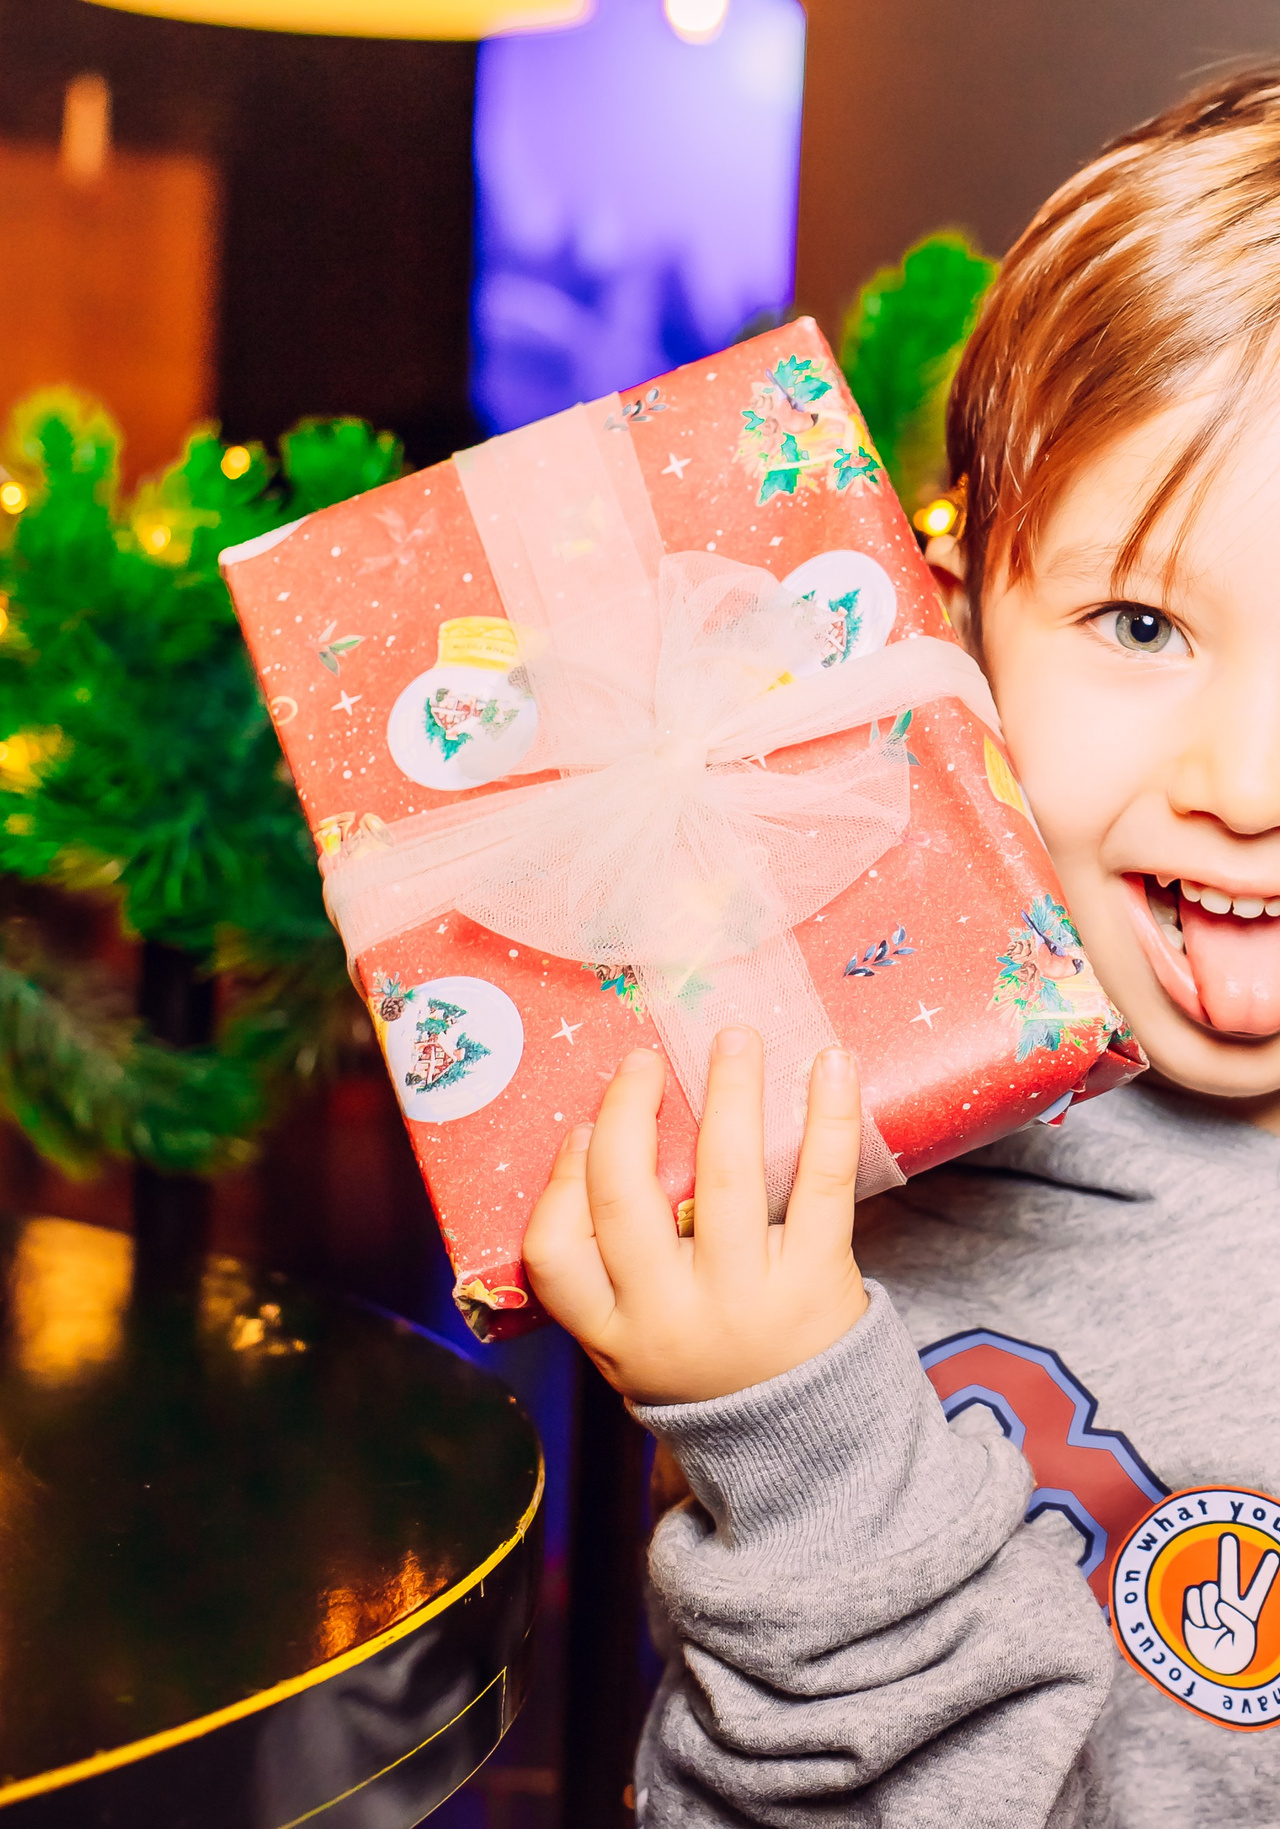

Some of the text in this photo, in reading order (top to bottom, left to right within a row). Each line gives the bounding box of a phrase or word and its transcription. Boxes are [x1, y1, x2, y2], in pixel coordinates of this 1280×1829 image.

[1137, 1499, 1208, 1553] what
[1124, 1569, 1142, 1604] on
[1130, 1621, 1196, 1699] focus
